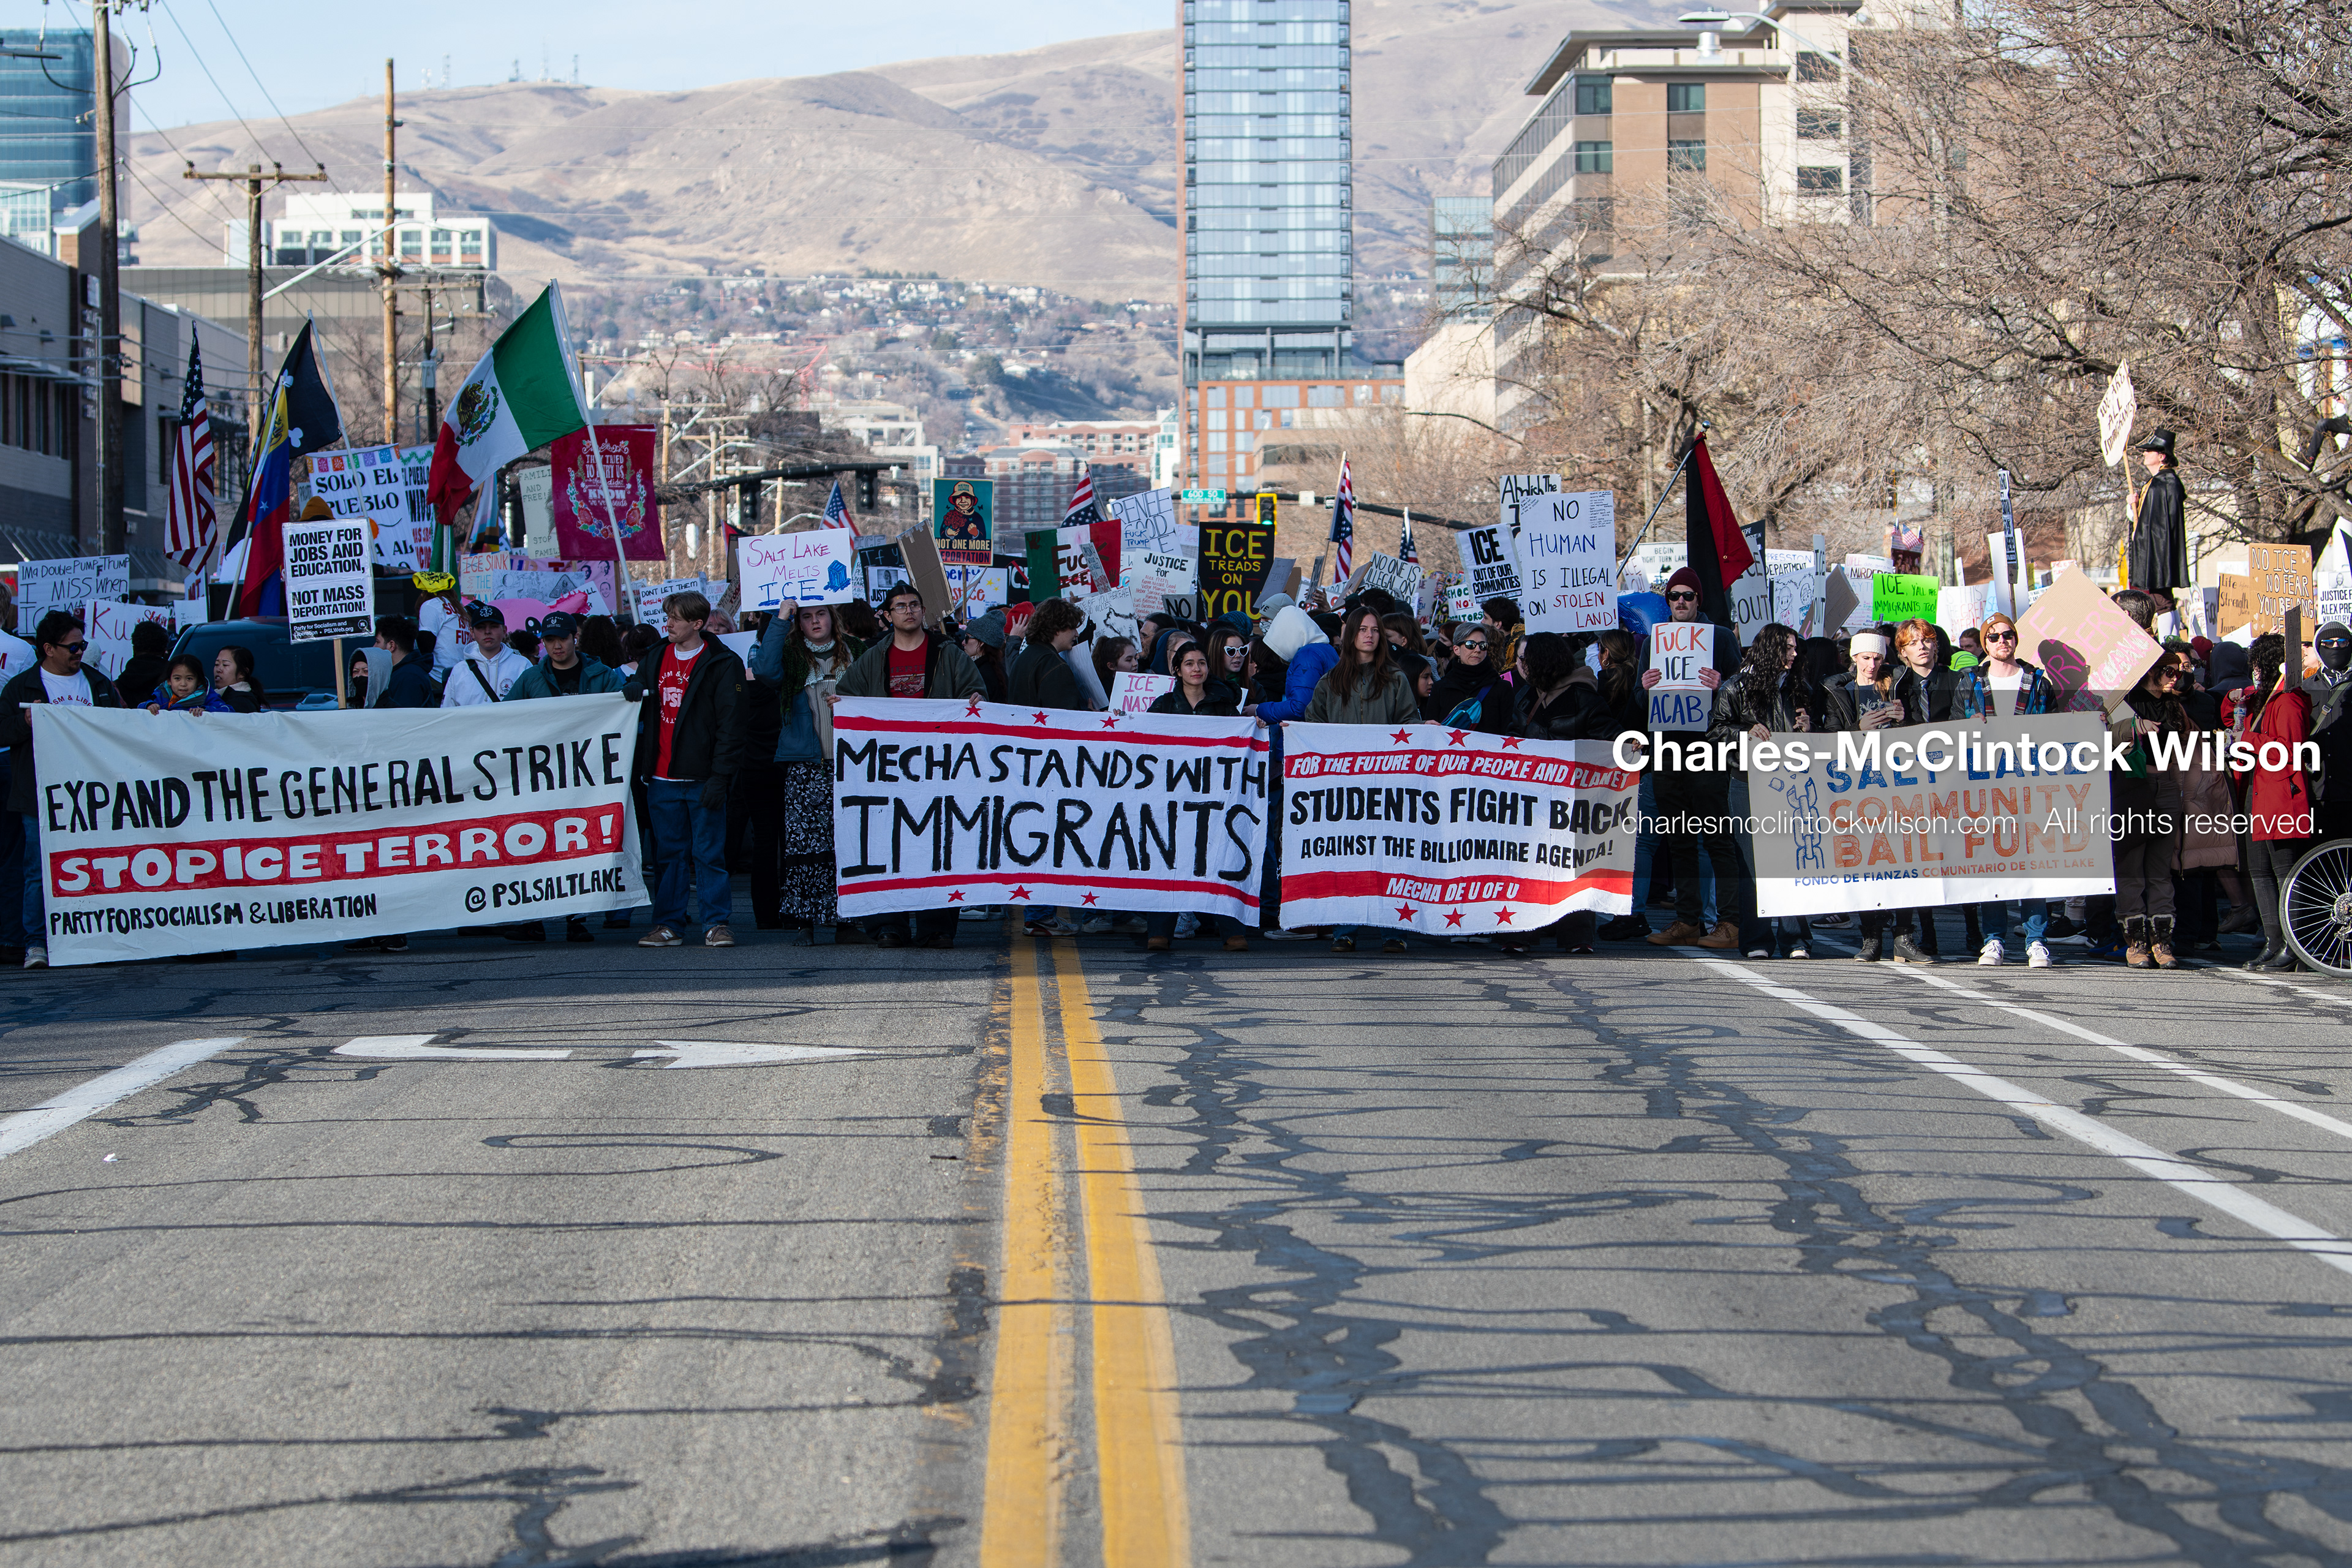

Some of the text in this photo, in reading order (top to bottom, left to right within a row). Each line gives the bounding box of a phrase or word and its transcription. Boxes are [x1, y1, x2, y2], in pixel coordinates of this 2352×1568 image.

[605, 454, 624, 463] TRIED
[315, 467, 399, 494] SOLO EL
[522, 492, 548, 502] FREE!
[1112, 490, 1173, 525] RENEE
[1553, 500, 1580, 522] NO
[290, 527, 362, 547] MONEY FOR
[936, 538, 990, 551] NOT ONE MORE
[1124, 530, 1147, 538] FUCK
[1529, 532, 1596, 557] HUMAN
[290, 542, 364, 564] JOBS AND
[747, 535, 831, 567] SALT LAKE
[940, 551, 990, 563] EPORTATION
[1051, 539, 1110, 574] FUCK
[1469, 527, 1505, 565] ICE
[291, 559, 365, 578] EDUCATION,
[462, 556, 484, 574] ICE
[1144, 552, 1188, 571] JUSTICE
[1209, 560, 1261, 572] TREADS
[1372, 553, 1421, 582] NO ONE IS
[1814, 549, 1826, 576] ICE
[2252, 547, 2297, 574] NO ICE
[773, 565, 820, 581] MELTS
[1156, 567, 1169, 577] for
[1222, 573, 1242, 585] ON
[1365, 568, 1415, 596] ILLEGAL ON
[1473, 564, 1513, 581] OUT OF OUR
[1532, 567, 1613, 589] IS ILLEGAL
[292, 585, 364, 606] NOT MASS
[641, 581, 698, 598] DONT LET THEM
[758, 579, 825, 604] ICE
[1472, 575, 1521, 595] COMMUNITIES
[2266, 573, 2310, 598] NO FEAR
[2321, 590, 2347, 601] JUSTICE
[292, 601, 366, 619] DEPORTATION!
[1165, 598, 1192, 619] NO
[1202, 589, 1262, 620] YOU
[1529, 599, 1546, 616] ON
[1553, 592, 1605, 608] STOLEN
[1738, 594, 1769, 624] OUT
[1874, 600, 1937, 615] IMMIGRANTS TOO!
[2257, 593, 2277, 616] YOU
[2321, 603, 2338, 615] ALEX
[1576, 608, 1617, 628] LAND!
[1656, 624, 1707, 654] FUCK
[1665, 656, 1696, 680] ICE
[1125, 674, 1159, 692] ICE
[1649, 693, 1704, 725] ACAB
[836, 737, 1266, 799] MECHA STANDS WITH
[1291, 753, 1629, 790] FOR THE FUTURE OF OUR PEOPLE AND PLANET
[45, 733, 624, 833] EXPAND THE GENERAL STRIKE
[1289, 786, 1632, 835] STUDENTS FIGHT BACK
[1828, 783, 2092, 829] COMMUNITY
[840, 794, 1262, 882] IMMIGRANTS
[1834, 820, 2090, 868] BAIL FUND
[58, 813, 614, 891] STOP ICE TERROR!
[1300, 835, 1614, 870] AGAINST THE BILLIONAIRE AGENDA!
[1794, 857, 2095, 887] FONDO DE FIANZAS COMUNITARIO DE SALT LAKE
[1386, 878, 1520, 902] MECHA DE U OF U
